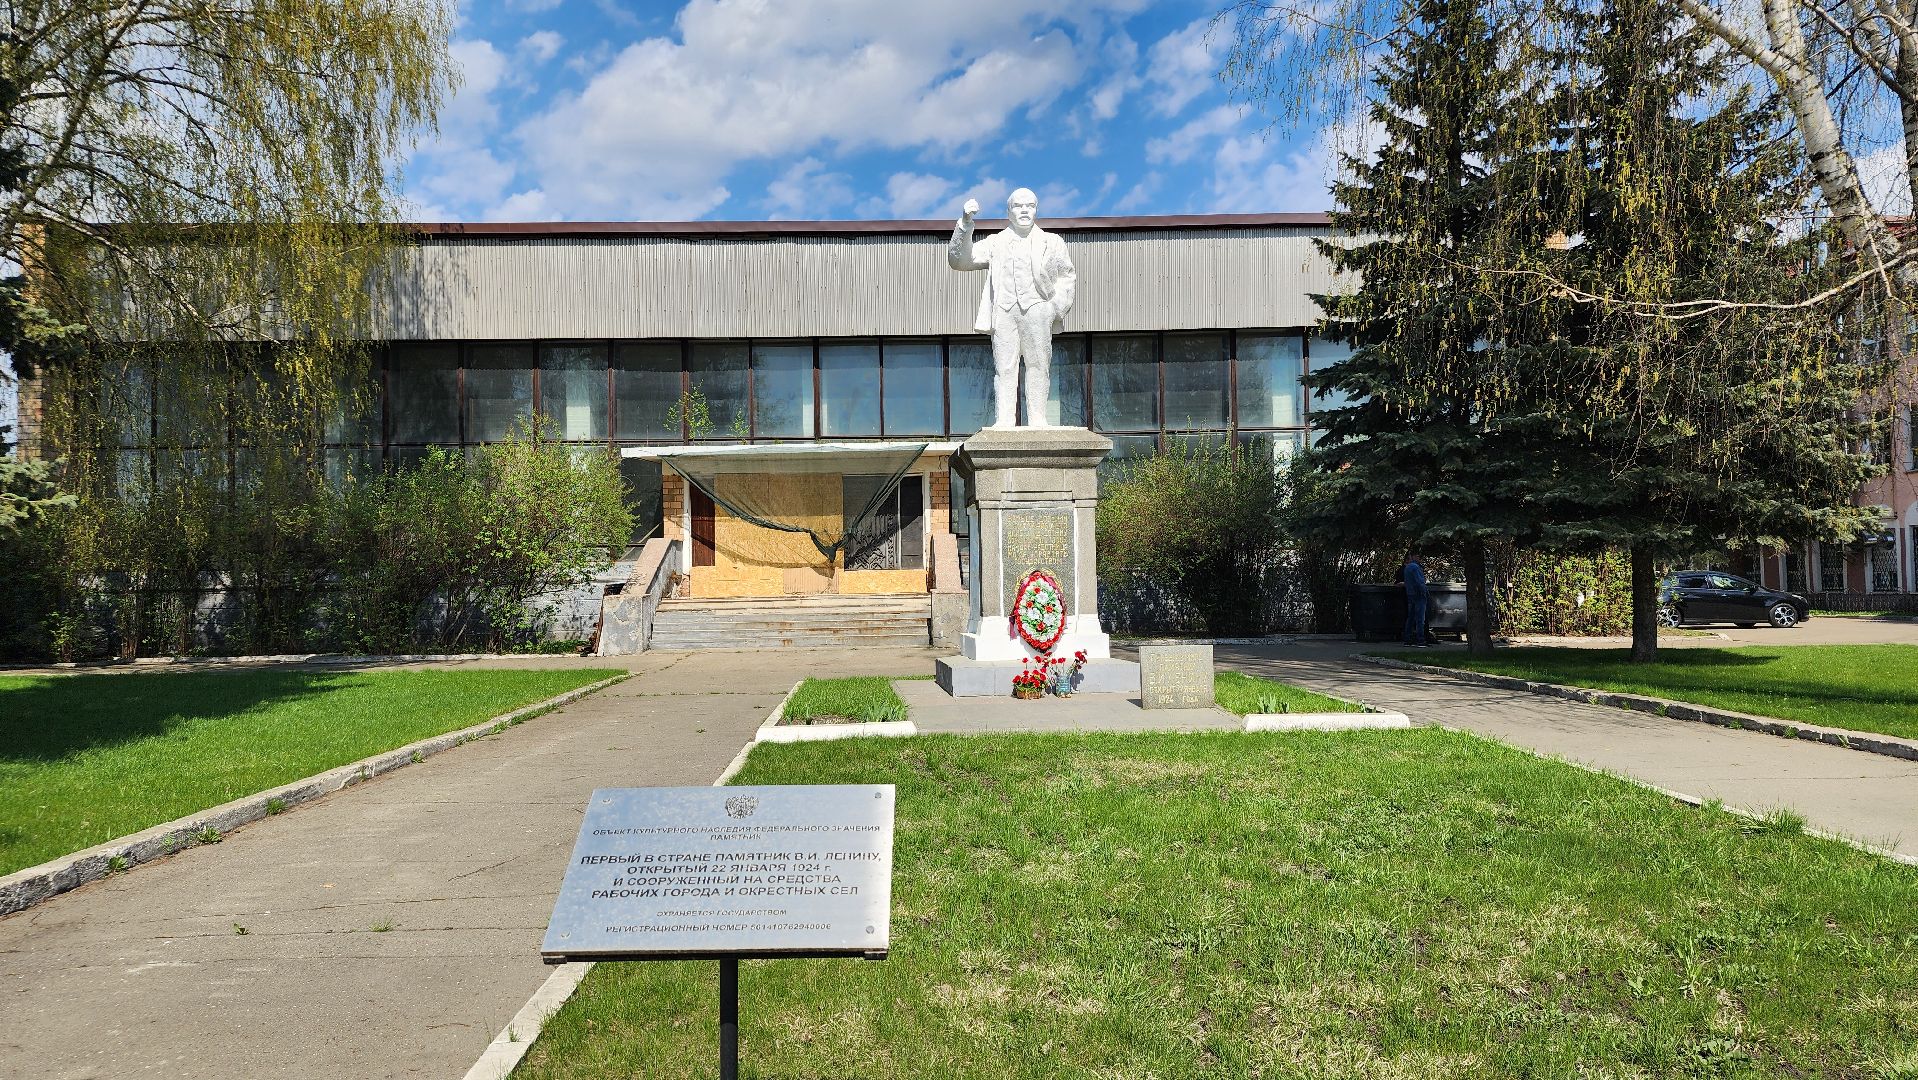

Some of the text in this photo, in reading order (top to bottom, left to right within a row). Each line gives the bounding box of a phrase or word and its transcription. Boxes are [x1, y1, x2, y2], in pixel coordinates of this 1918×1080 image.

[581, 852, 881, 865] ПЕРВЫЙ В СТРАНЕ ПАМЯТНИК В.И. ЛЕНИНУ,
[627, 863, 708, 875] ОТКРЫТЫЙ
[710, 864, 726, 873] 22
[729, 864, 786, 873] ЯНВАРЯ
[792, 863, 820, 872] 1924
[613, 874, 842, 887] И СООРУЖЕННЫЙ НА СРЕДСТВА
[591, 886, 859, 899] РАБОЧИХ ГОРОДА И ОКРЕСТНЫХ СЕЛ
[606, 922, 710, 934] РЕГИСТРАЦИОННЫЙ
[712, 923, 748, 931] НОМЕР
